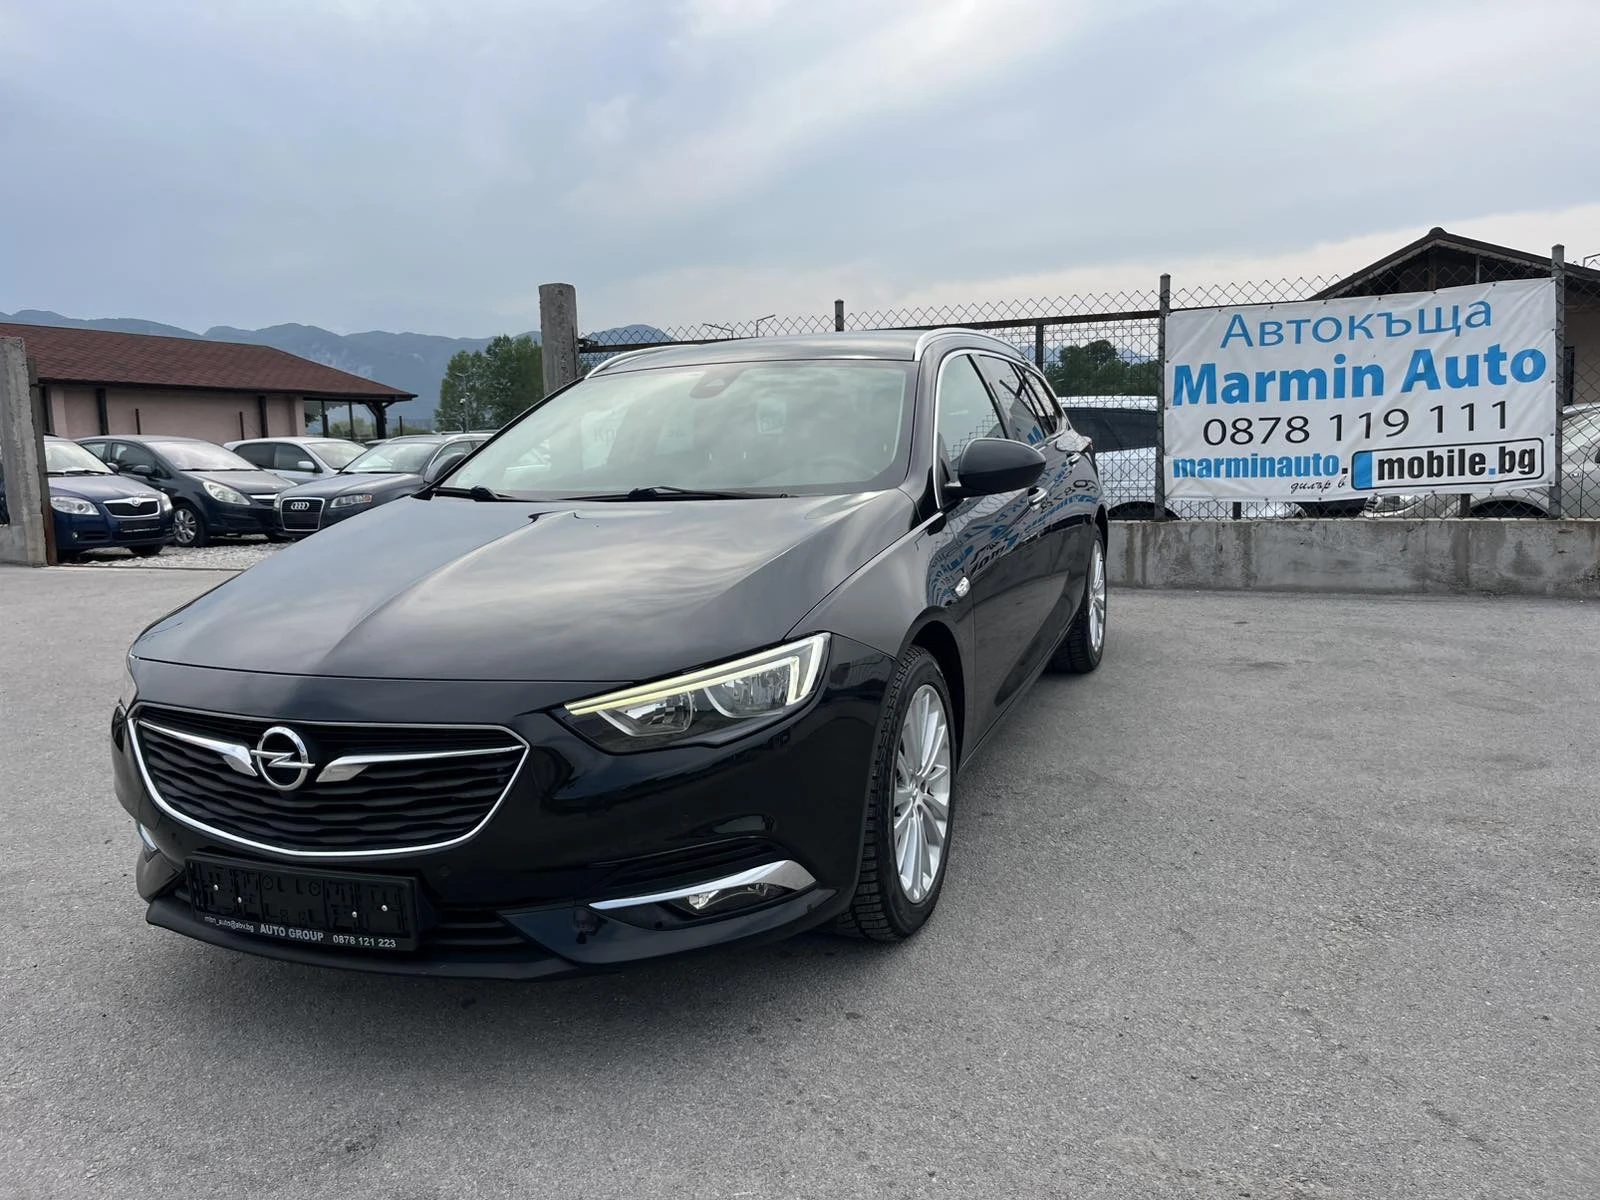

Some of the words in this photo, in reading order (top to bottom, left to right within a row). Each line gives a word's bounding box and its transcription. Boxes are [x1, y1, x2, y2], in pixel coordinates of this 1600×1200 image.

[1220, 300, 1491, 348] Автокъща
[1172, 354, 1385, 406] Marmin
[1400, 343, 1546, 393] Auto
[1203, 415, 1310, 446] 0878
[1329, 408, 1409, 441] 119
[1430, 400, 1506, 433] 111
[1377, 445, 1536, 481] mobile.bg
[259, 923, 286, 936] AUTO
[288, 928, 324, 942] GROUP
[332, 934, 356, 945] 0878
[358, 937, 375, 946] 121
[378, 938, 396, 948] 223
